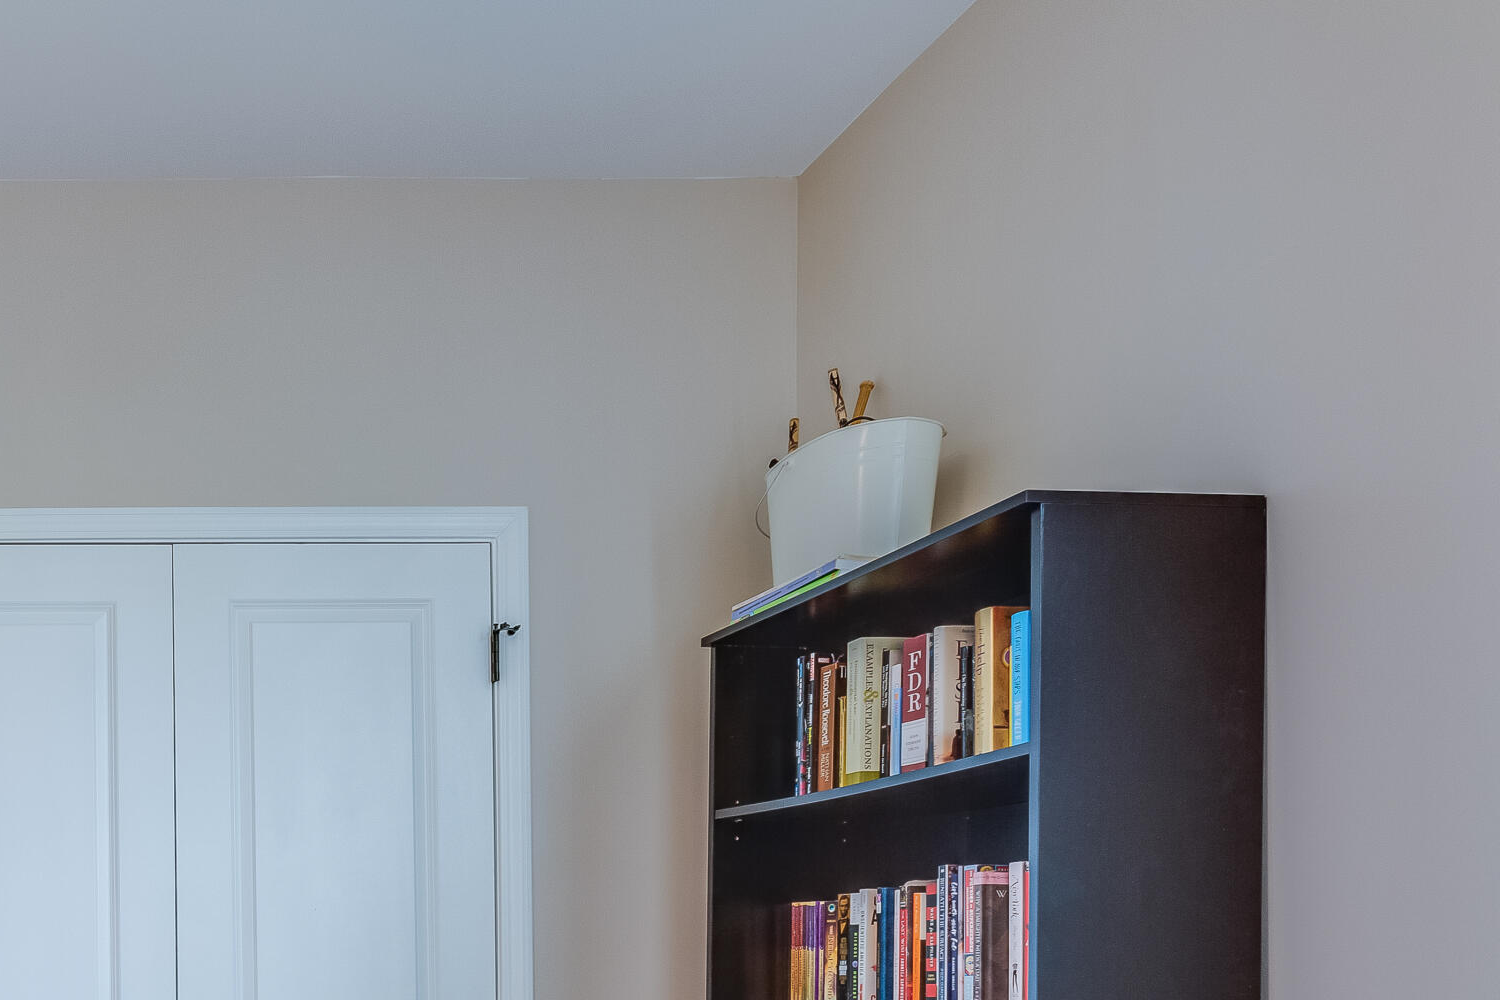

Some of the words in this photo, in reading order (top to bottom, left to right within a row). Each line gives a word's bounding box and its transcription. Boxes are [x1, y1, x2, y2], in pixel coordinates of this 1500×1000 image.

[866, 643, 875, 691] EXAMPLES
[976, 643, 987, 676] Help
[821, 669, 832, 708] Theodore
[907, 650, 922, 713] FDR
[821, 709, 831, 746] Roosevelt
[864, 701, 875, 770] EXPLANATIONS
